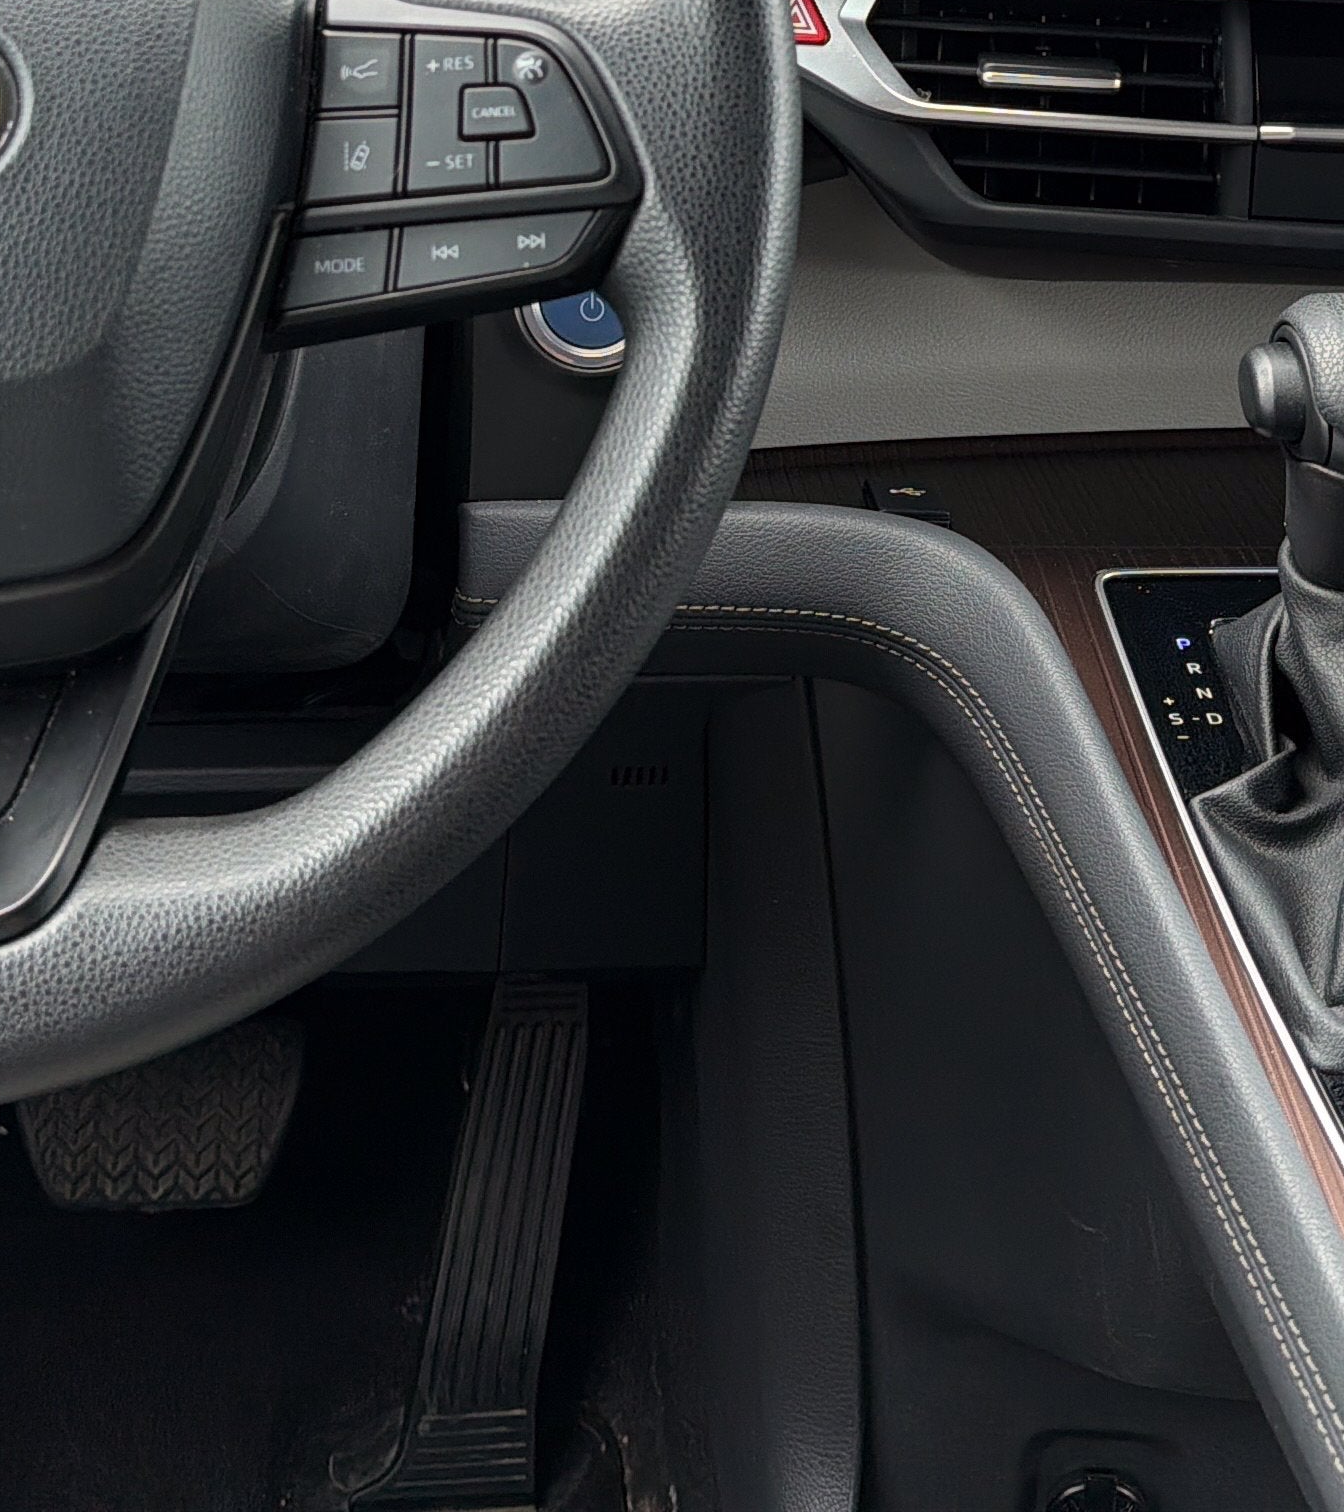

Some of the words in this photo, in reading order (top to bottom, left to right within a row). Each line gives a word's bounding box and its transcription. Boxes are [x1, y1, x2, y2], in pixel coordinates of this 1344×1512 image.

[471, 106, 516, 119] CANCEL
[315, 257, 366, 274] MODE
[1176, 638, 1191, 650] P
[1186, 662, 1202, 674] R
[1196, 687, 1214, 700] N
[1168, 713, 1184, 726] S
[1206, 713, 1224, 725] D
